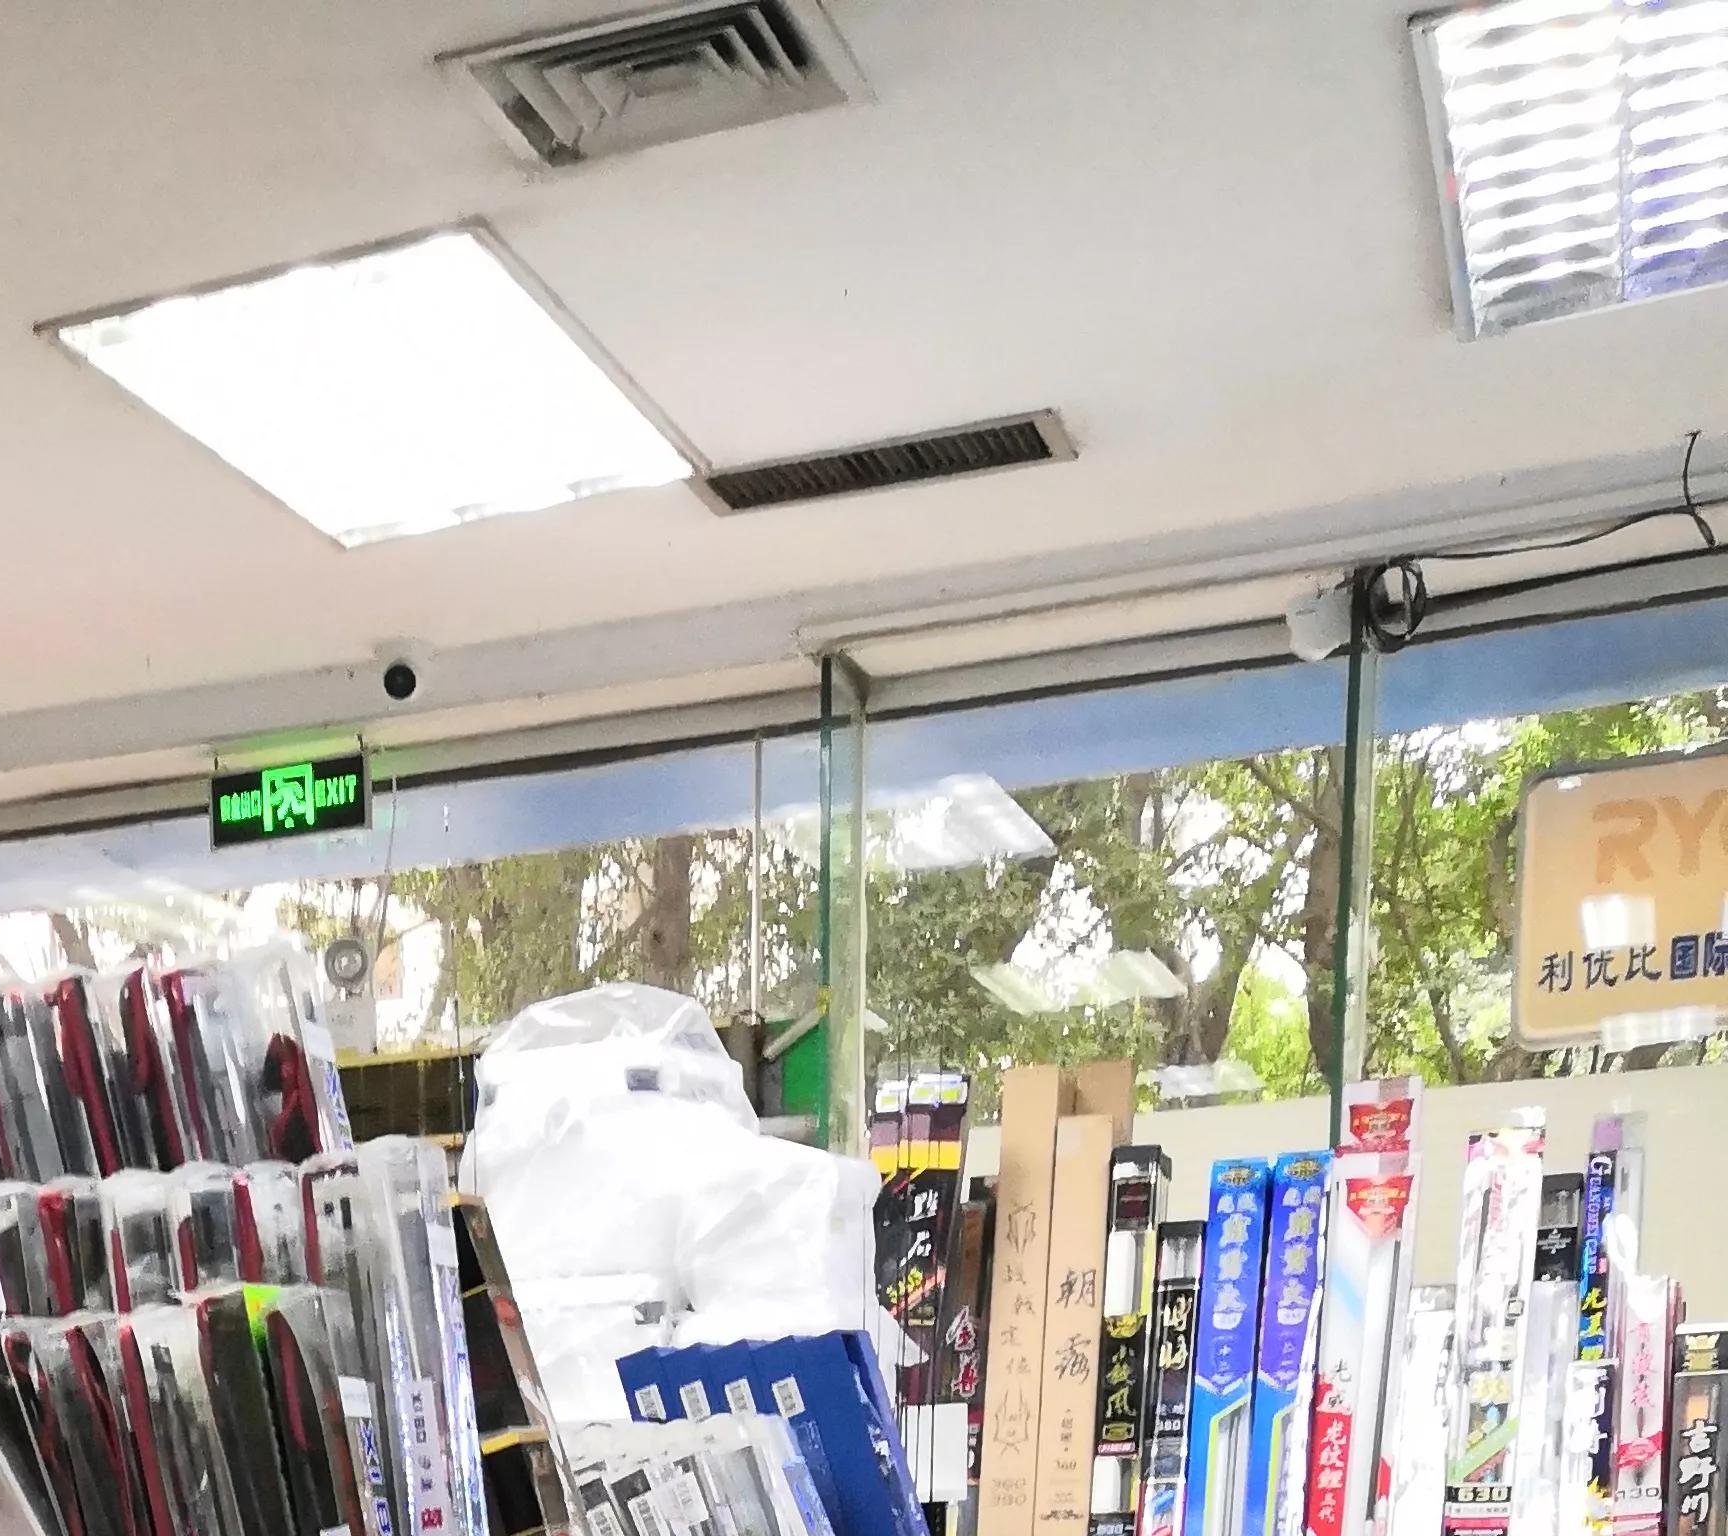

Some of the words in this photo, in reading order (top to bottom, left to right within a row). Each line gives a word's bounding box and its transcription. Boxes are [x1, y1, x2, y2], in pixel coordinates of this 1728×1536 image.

[315, 774, 357, 808] EXIT
[1591, 786, 1728, 884] RY
[1458, 1485, 1509, 1503] 630
